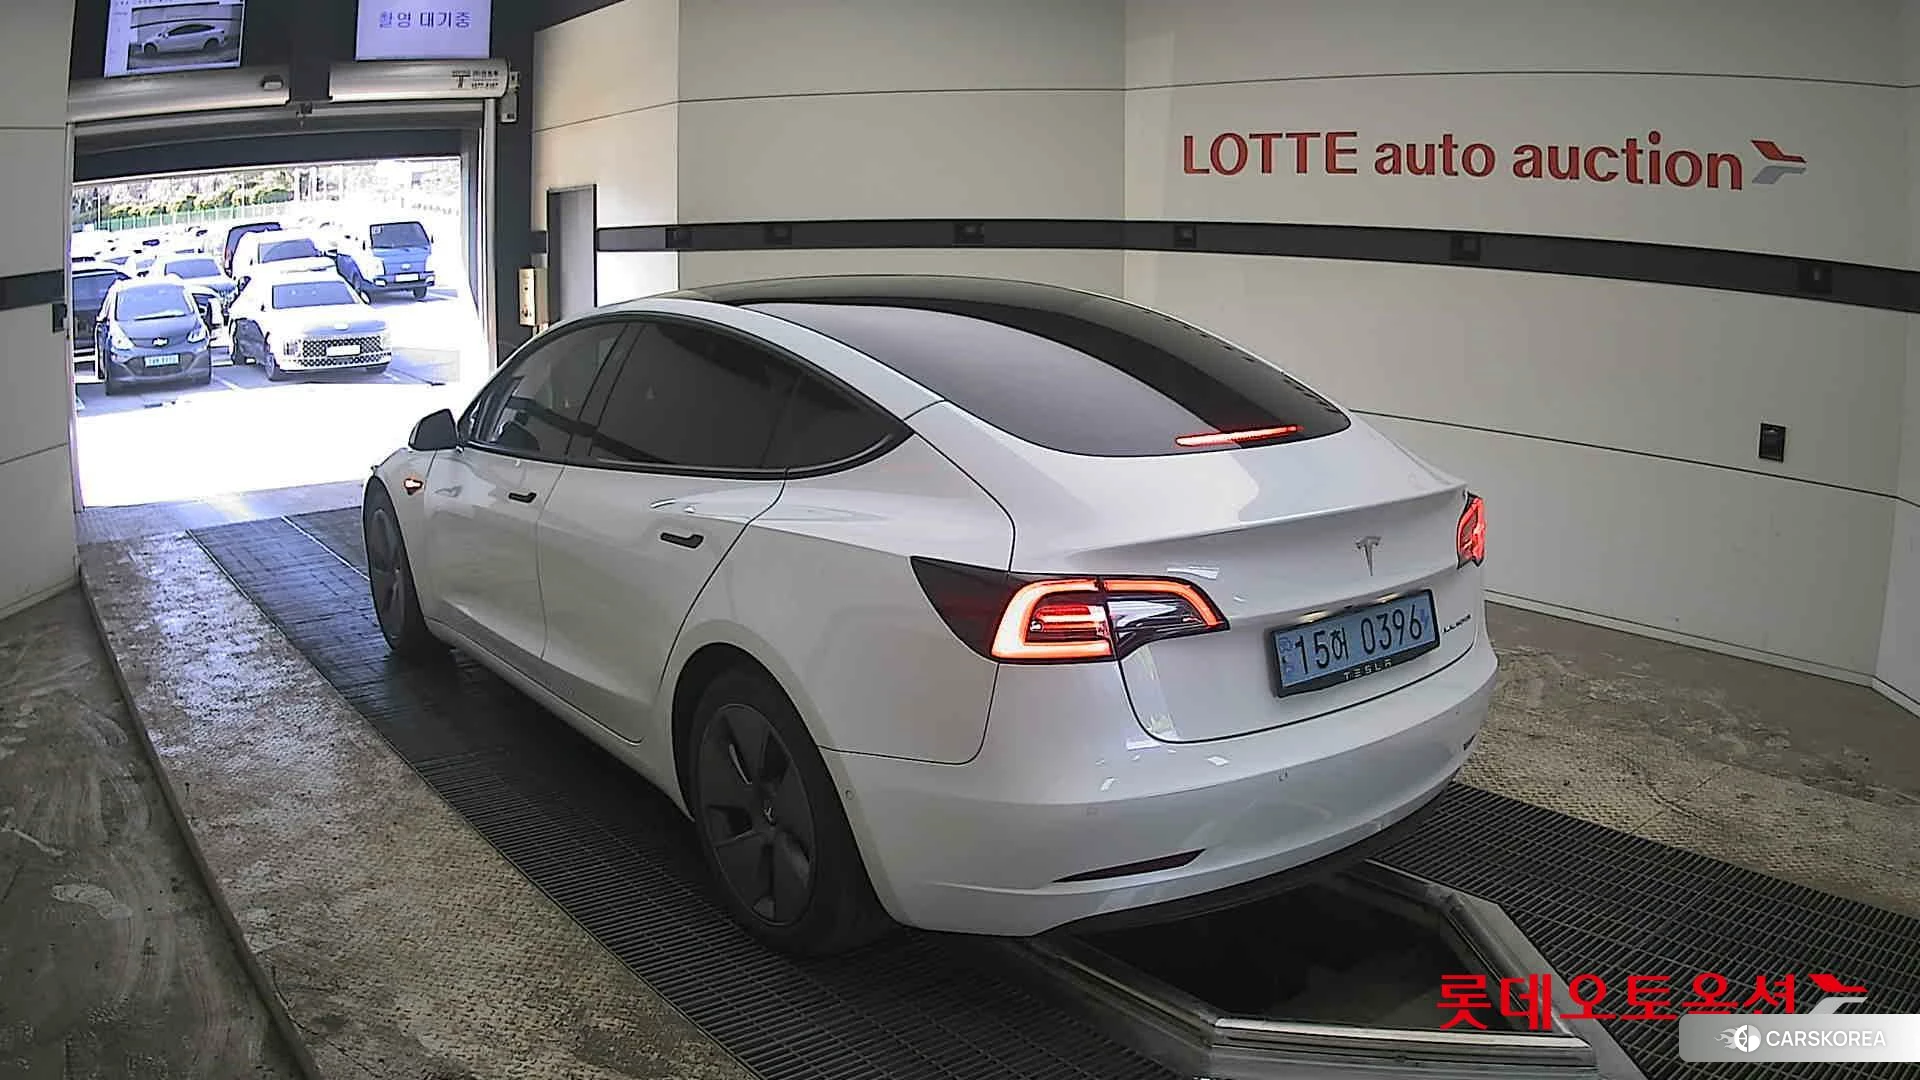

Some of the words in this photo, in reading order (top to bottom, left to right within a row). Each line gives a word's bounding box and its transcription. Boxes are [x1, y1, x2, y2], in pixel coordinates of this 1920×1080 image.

[420, 11, 472, 29] 대기중
[1183, 131, 1358, 176] LOTTE
[1374, 133, 1496, 177] auto
[1512, 130, 1743, 190] auction
[1295, 627, 1349, 675] 15허
[1361, 604, 1422, 655] 0396
[1343, 658, 1392, 681] TESLA
